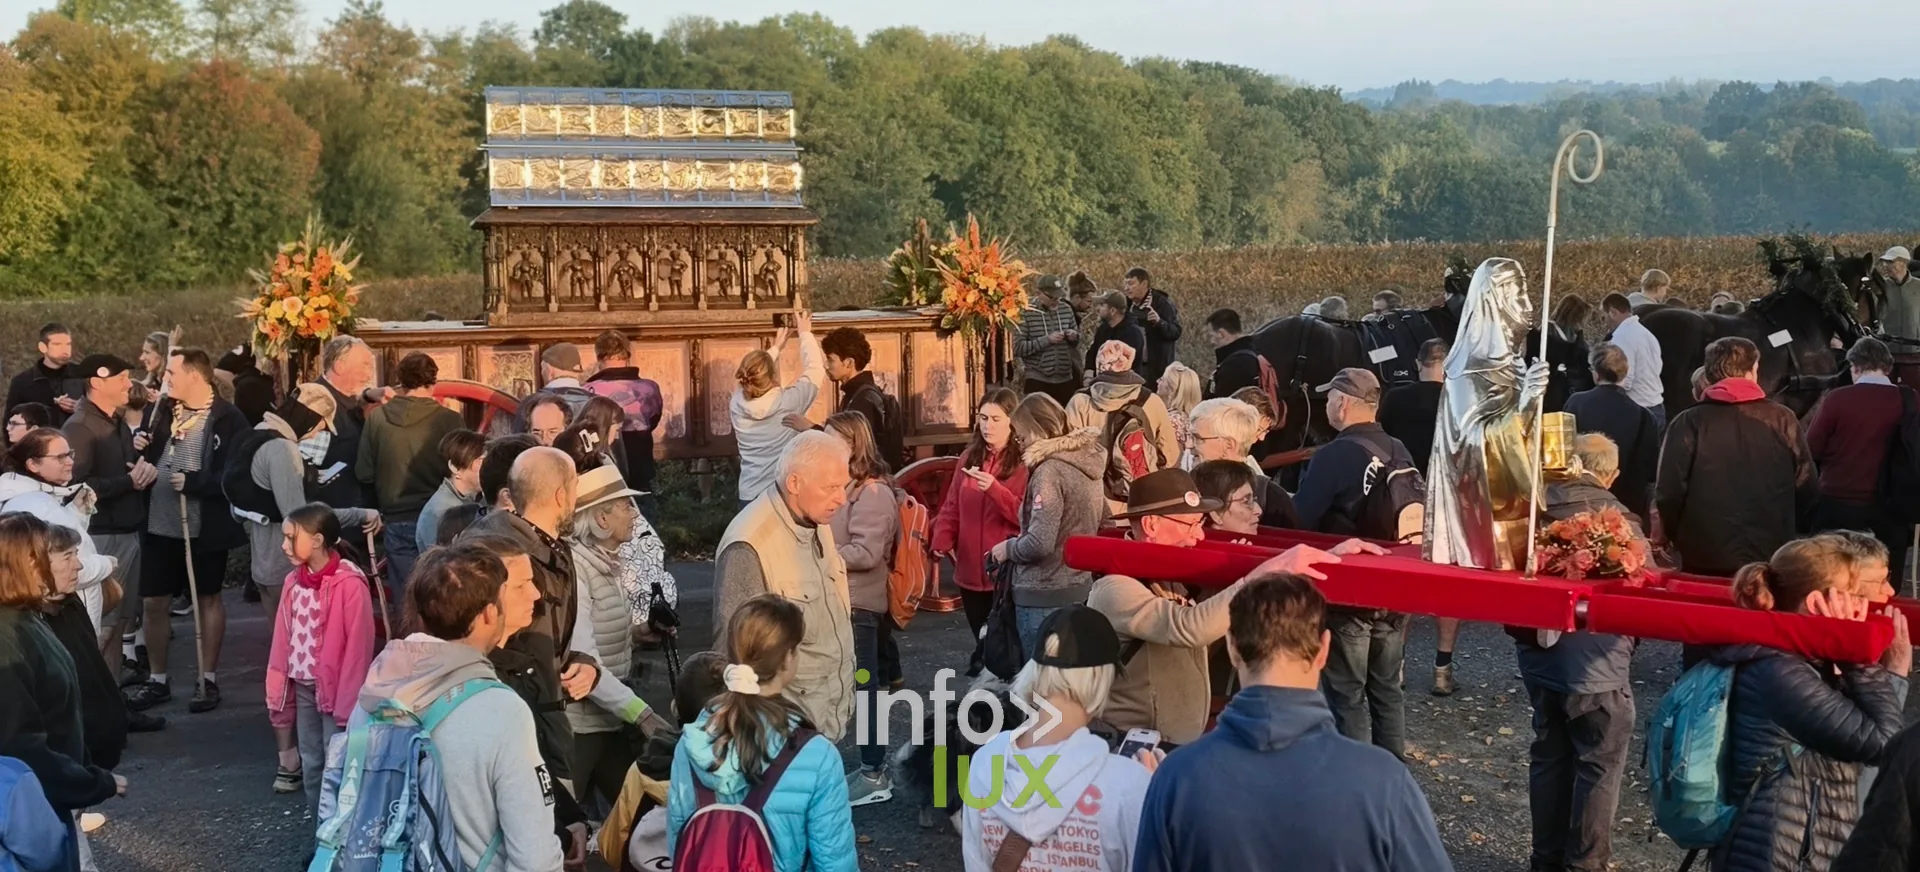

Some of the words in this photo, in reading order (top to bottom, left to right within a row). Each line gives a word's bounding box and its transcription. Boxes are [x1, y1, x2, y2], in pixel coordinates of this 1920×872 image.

[1059, 825, 1099, 841] TOKYO
[1052, 840, 1100, 857] ANGELES
[1047, 854, 1101, 870] ISTANBUL
